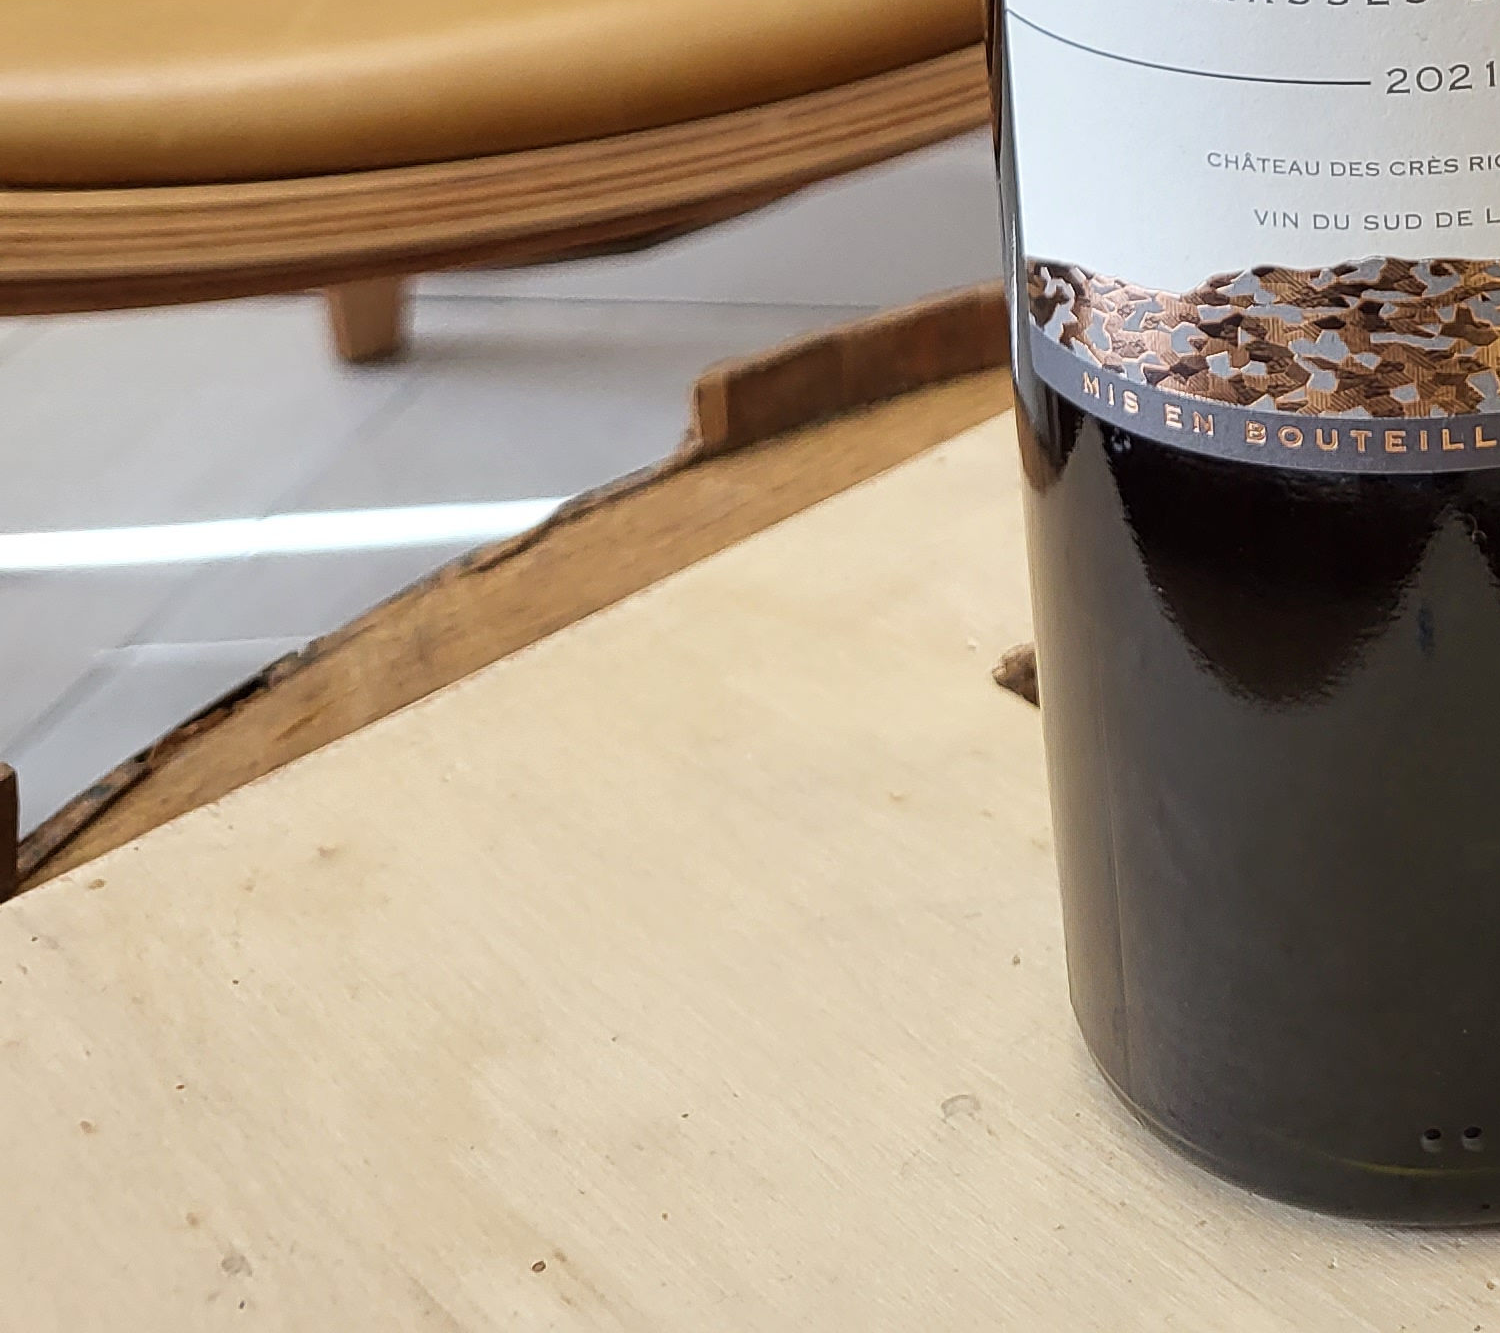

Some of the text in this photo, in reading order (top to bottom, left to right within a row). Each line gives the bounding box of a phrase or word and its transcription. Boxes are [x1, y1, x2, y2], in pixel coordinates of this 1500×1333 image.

[1385, 60, 1498, 96] 2021
[1207, 150, 1321, 177] CHÂTEAU
[1329, 161, 1381, 178] DES
[1389, 153, 1459, 177] CRÈS
[1253, 208, 1299, 230] VIN
[1312, 213, 1350, 231] DU
[1363, 213, 1422, 231] SUD
[1435, 209, 1473, 229] DE
[1082, 370, 1141, 415] MIS
[1163, 405, 1215, 437] EN
